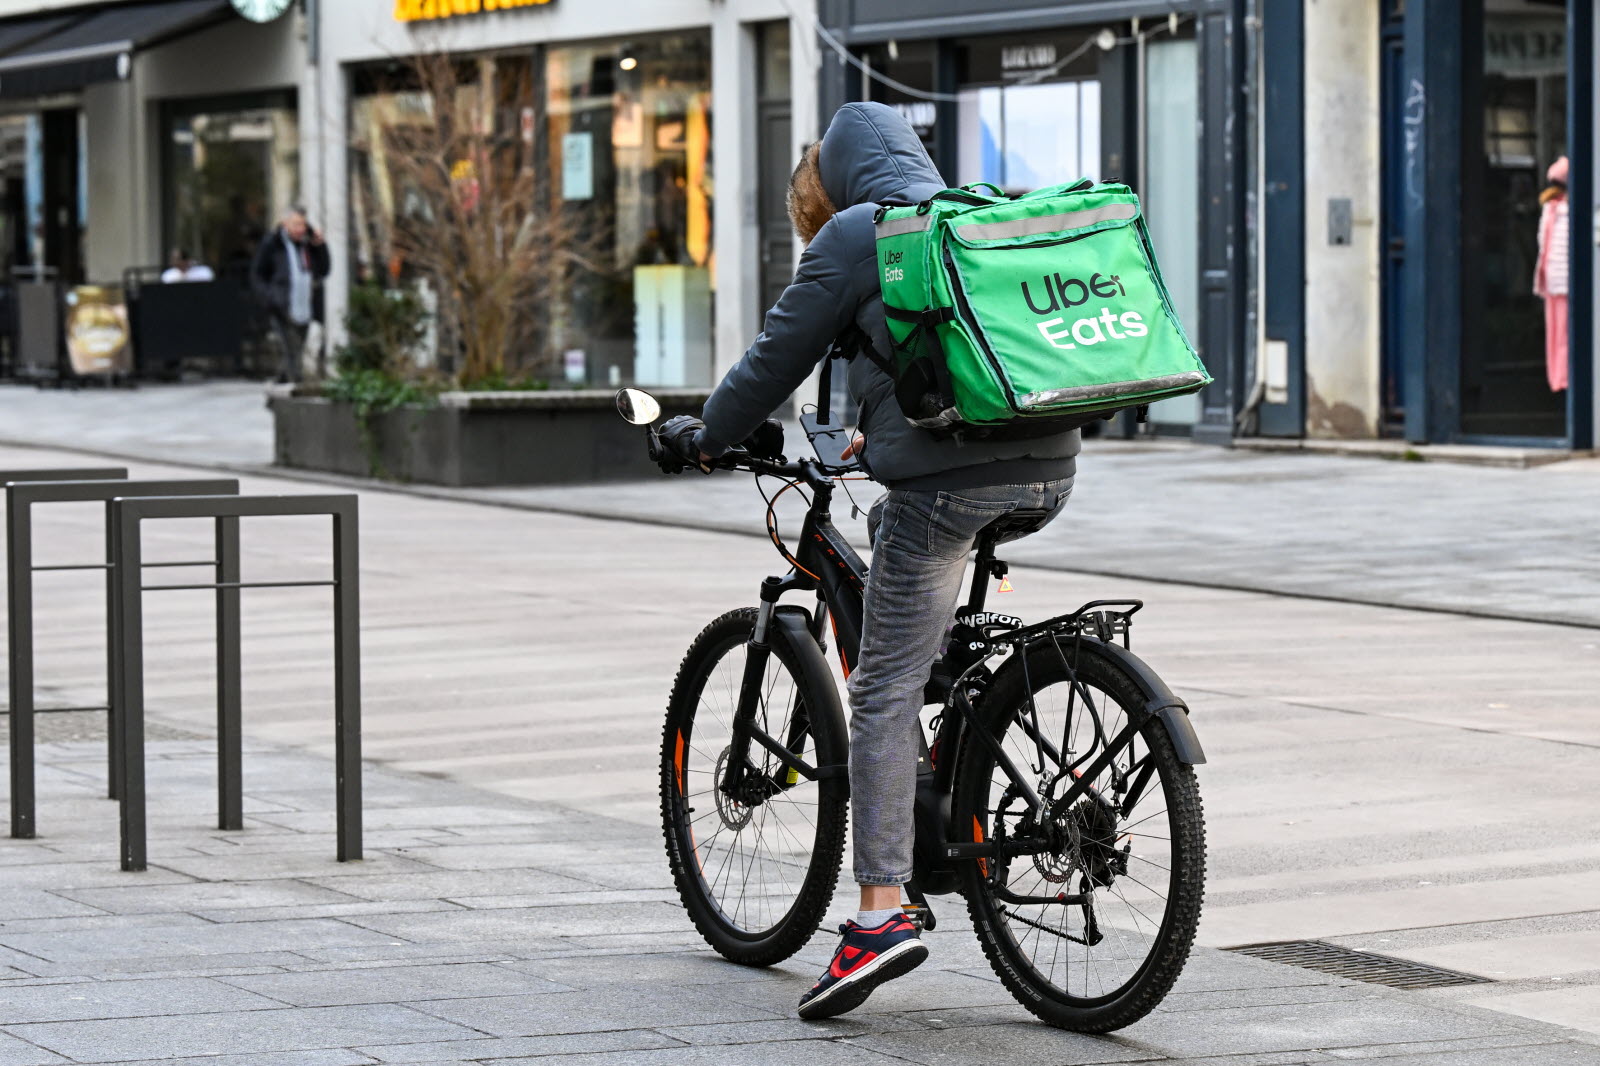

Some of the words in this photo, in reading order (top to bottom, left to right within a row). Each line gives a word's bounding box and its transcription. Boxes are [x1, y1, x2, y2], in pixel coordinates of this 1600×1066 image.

[884, 250, 904, 265] Uber
[885, 267, 904, 283] Eats
[1020, 272, 1126, 315] Uber
[1036, 307, 1149, 350] Eats
[981, 920, 1043, 1002] SCHWALBE
